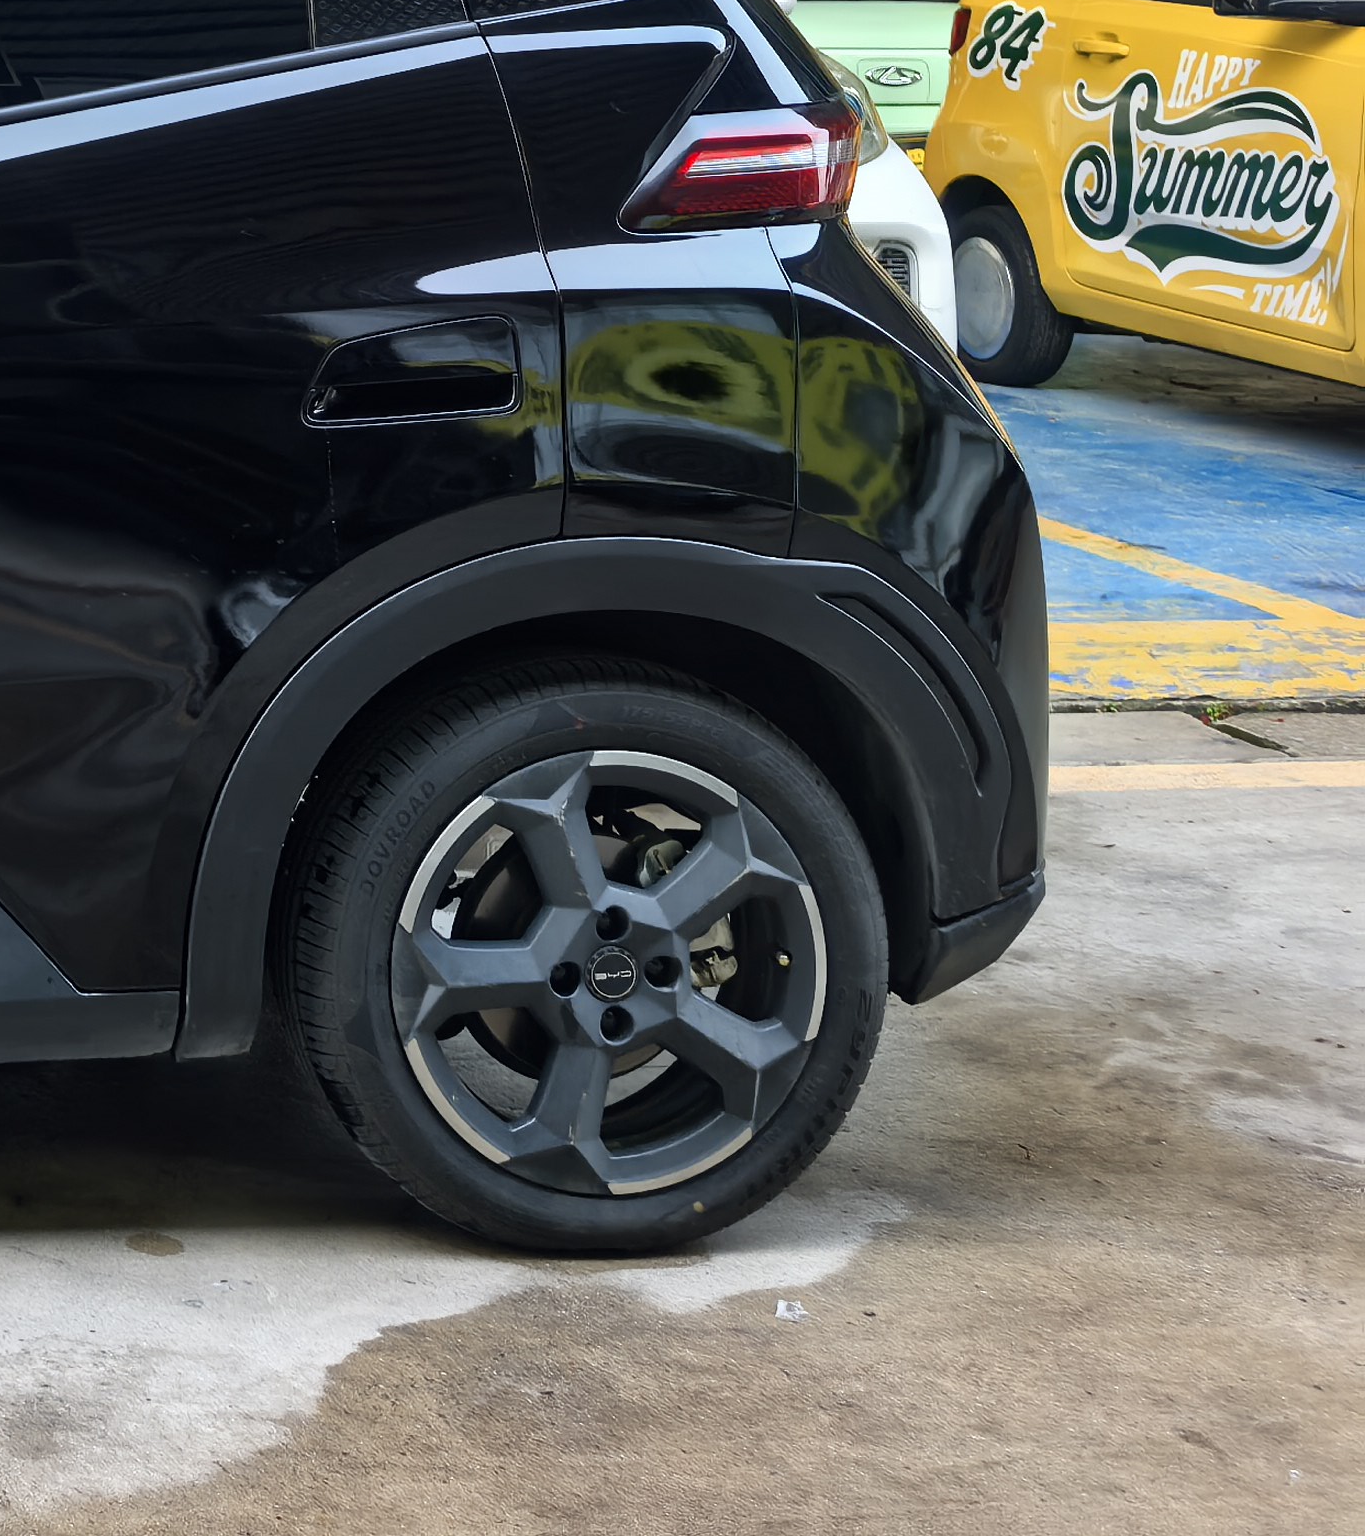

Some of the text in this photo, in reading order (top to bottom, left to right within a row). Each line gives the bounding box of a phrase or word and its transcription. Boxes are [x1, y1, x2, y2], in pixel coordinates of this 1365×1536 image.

[970, 2, 1053, 88] 84
[1168, 48, 1261, 109] HAPPY
[1063, 69, 1338, 272] Summer
